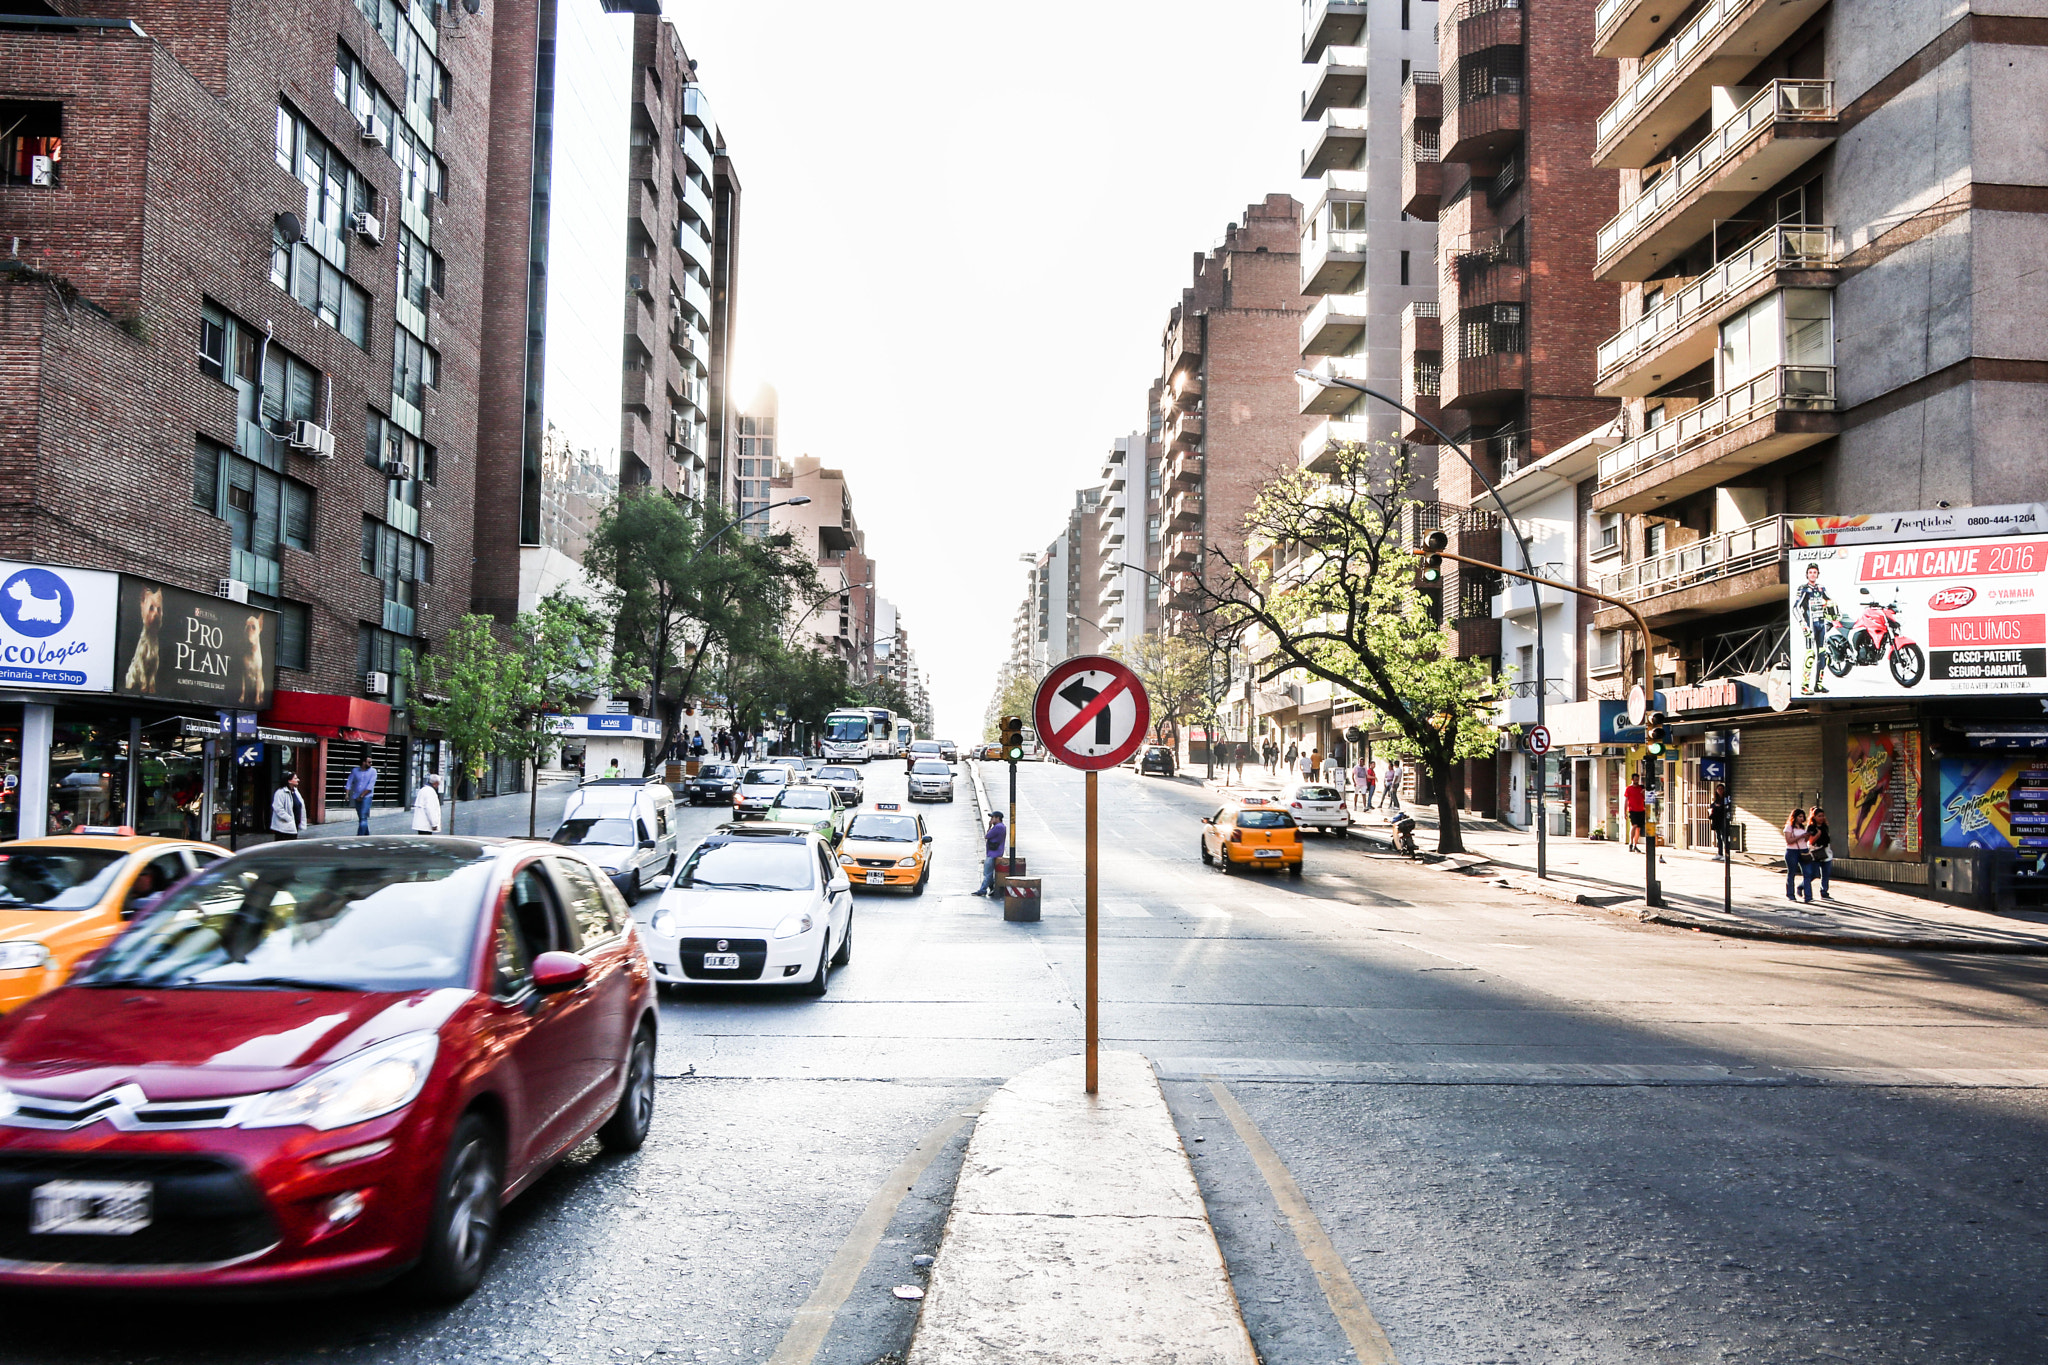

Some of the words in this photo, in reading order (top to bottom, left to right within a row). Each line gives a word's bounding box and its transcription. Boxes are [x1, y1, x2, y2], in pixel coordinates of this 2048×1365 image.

[1805, 524, 1883, 536] www.sietesentidos.com.ar
[1968, 514, 2036, 526] 0800-444-1204
[1872, 552, 1918, 578] PLAN
[1922, 548, 1980, 574] CANJE
[1988, 546, 2035, 572] 2016
[1936, 589, 1970, 605] Plaza
[1998, 588, 2034, 598] YAMAHA
[186, 616, 223, 649] PRO
[1950, 618, 2021, 640] INCLUÍMOS
[175, 642, 230, 676] PLAN
[1952, 650, 2022, 663] CASCO-PATENTE
[42, 672, 57, 680] Pet
[58, 672, 83, 683] Shop
[1948, 663, 2028, 678] SEGURO-GARANTÍA
[1944, 789, 2006, 824] Septiembre
